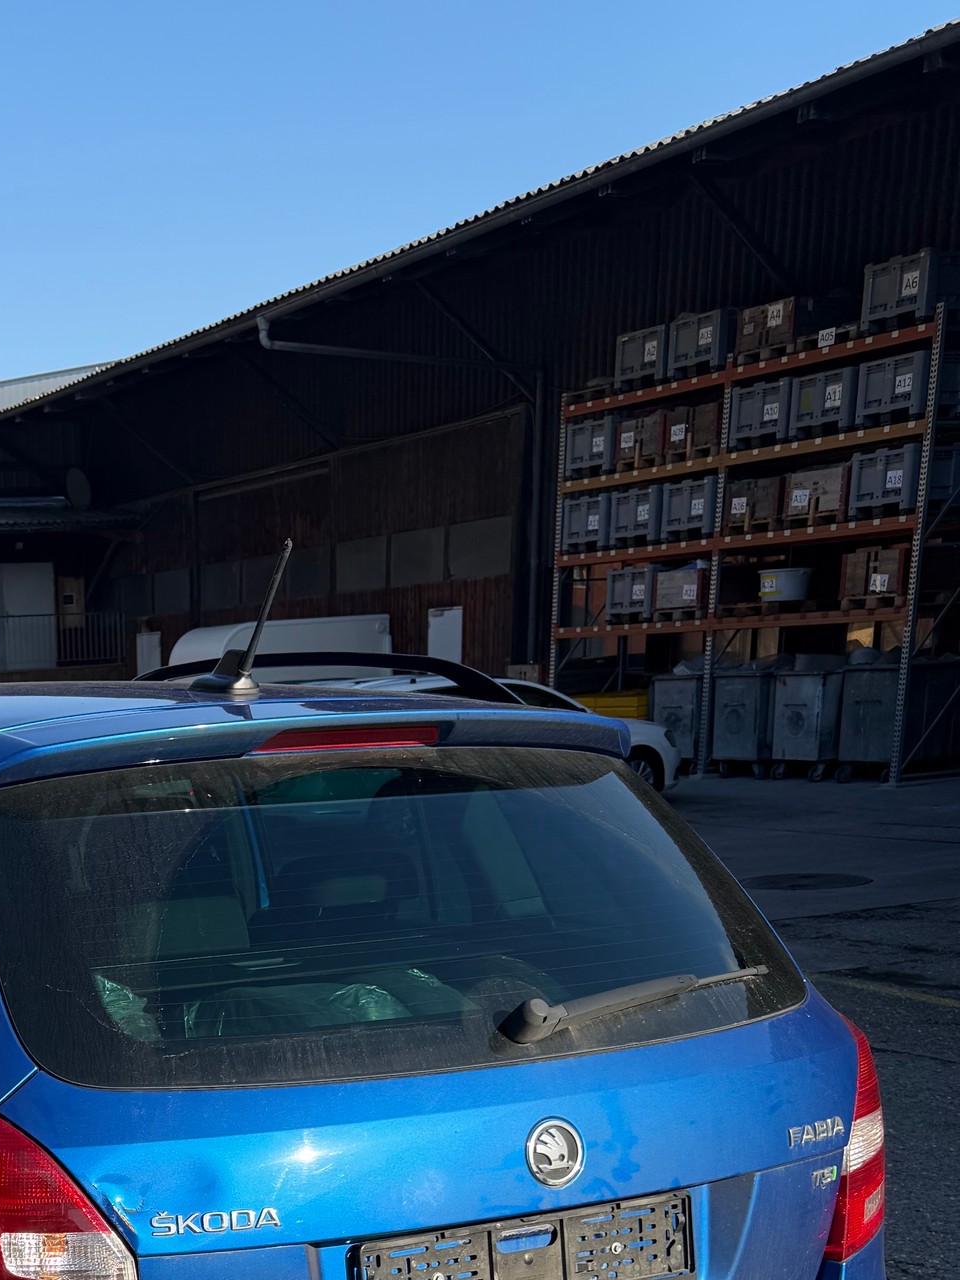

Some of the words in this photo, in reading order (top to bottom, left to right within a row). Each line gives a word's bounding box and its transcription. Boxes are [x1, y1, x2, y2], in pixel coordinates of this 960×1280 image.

[904, 276, 917, 291] A6
[770, 309, 781, 321] A4
[819, 332, 834, 343] A05
[646, 345, 657, 356] A2
[896, 377, 912, 390] A12
[825, 389, 841, 403] A11
[764, 406, 778, 417] A10
[886, 475, 902, 486] A18
[793, 494, 808, 504] A17
[871, 579, 886, 588] A4
[787, 1115, 845, 1149] FABIA
[150, 1206, 282, 1237] ŠKODA
